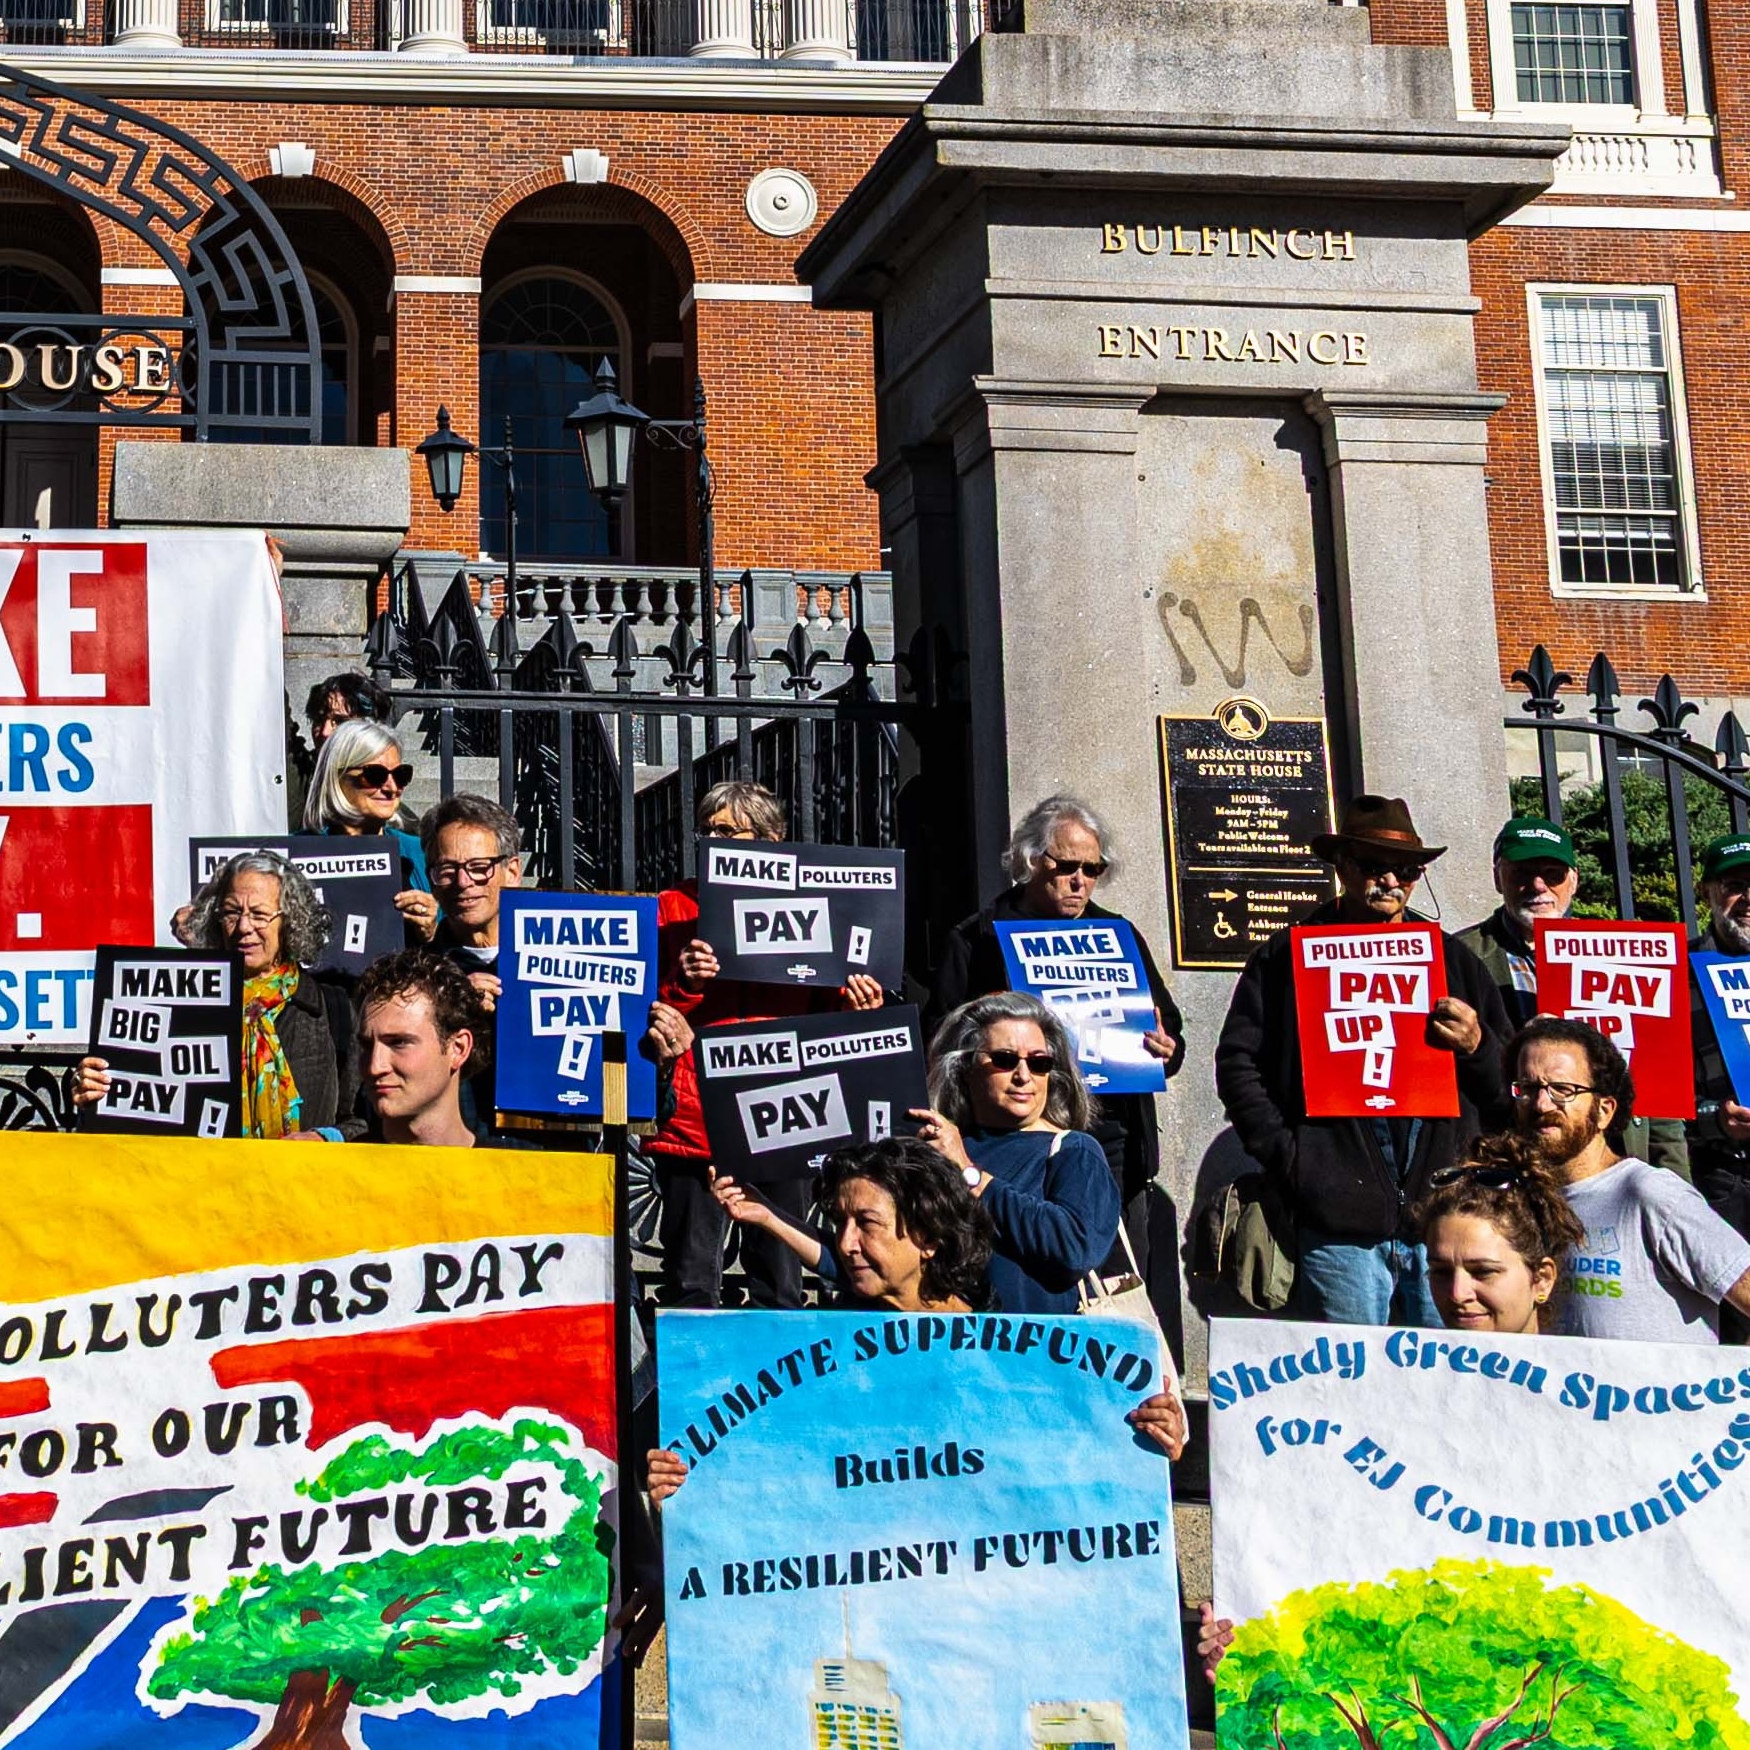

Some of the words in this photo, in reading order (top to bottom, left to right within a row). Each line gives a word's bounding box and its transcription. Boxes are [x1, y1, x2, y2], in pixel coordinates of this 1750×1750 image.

[1101, 223, 1357, 261] BULFINCH
[1098, 325, 1371, 365] ENTRANCE
[1185, 748, 1312, 763] MASSACHUSETTS
[1198, 764, 1246, 776] STATE
[1250, 765, 1302, 777] HOUSE
[298, 858, 387, 874] POLLUTERS
[715, 856, 790, 882] MAKE
[802, 870, 893, 885] POLLUTERS
[351, 923, 360, 944] !
[523, 916, 629, 946] MAKE
[744, 910, 819, 943] PAY
[855, 934, 864, 956] !
[1020, 933, 1115, 958] MAKE
[1311, 938, 1424, 961] POLLUTERS
[1554, 938, 1668, 958] POLLUTERS
[121, 968, 222, 998] MAKE
[526, 955, 637, 987] POLLUTERS
[1033, 964, 1130, 983] POLLUTERS
[1339, 972, 1420, 1005] PAY
[1581, 970, 1662, 1008] PAY
[109, 1008, 161, 1044] BIG
[539, 995, 612, 1028] PAY
[1334, 1015, 1383, 1043] UP
[170, 1044, 220, 1076] OIL
[568, 1040, 585, 1072] !
[709, 1040, 793, 1070] MAKE
[805, 1033, 908, 1061] POLLUTERS
[1372, 1052, 1385, 1081] !
[106, 1077, 179, 1115] PAY
[206, 1106, 222, 1135] !
[749, 1087, 830, 1139] PAY
[875, 1110, 884, 1134] !
[415, 1242, 565, 1314] PAY
[854, 1315, 1154, 1393] SUPERFUND
[1208, 1335, 1366, 1411] Shady
[1384, 1330, 1548, 1396] Green
[1559, 1367, 1750, 1421] Spaces
[152, 1394, 302, 1458] OUR
[834, 1441, 986, 1489] Builds
[1255, 1415, 1343, 1456] for
[1343, 1436, 1407, 1491] EJ
[1414, 1412, 1750, 1548] Communities
[227, 1478, 549, 1571] FUTURE
[679, 1566, 707, 1601] A
[722, 1539, 957, 1597] RESILIENT
[973, 1520, 1161, 1573] FUTURE
